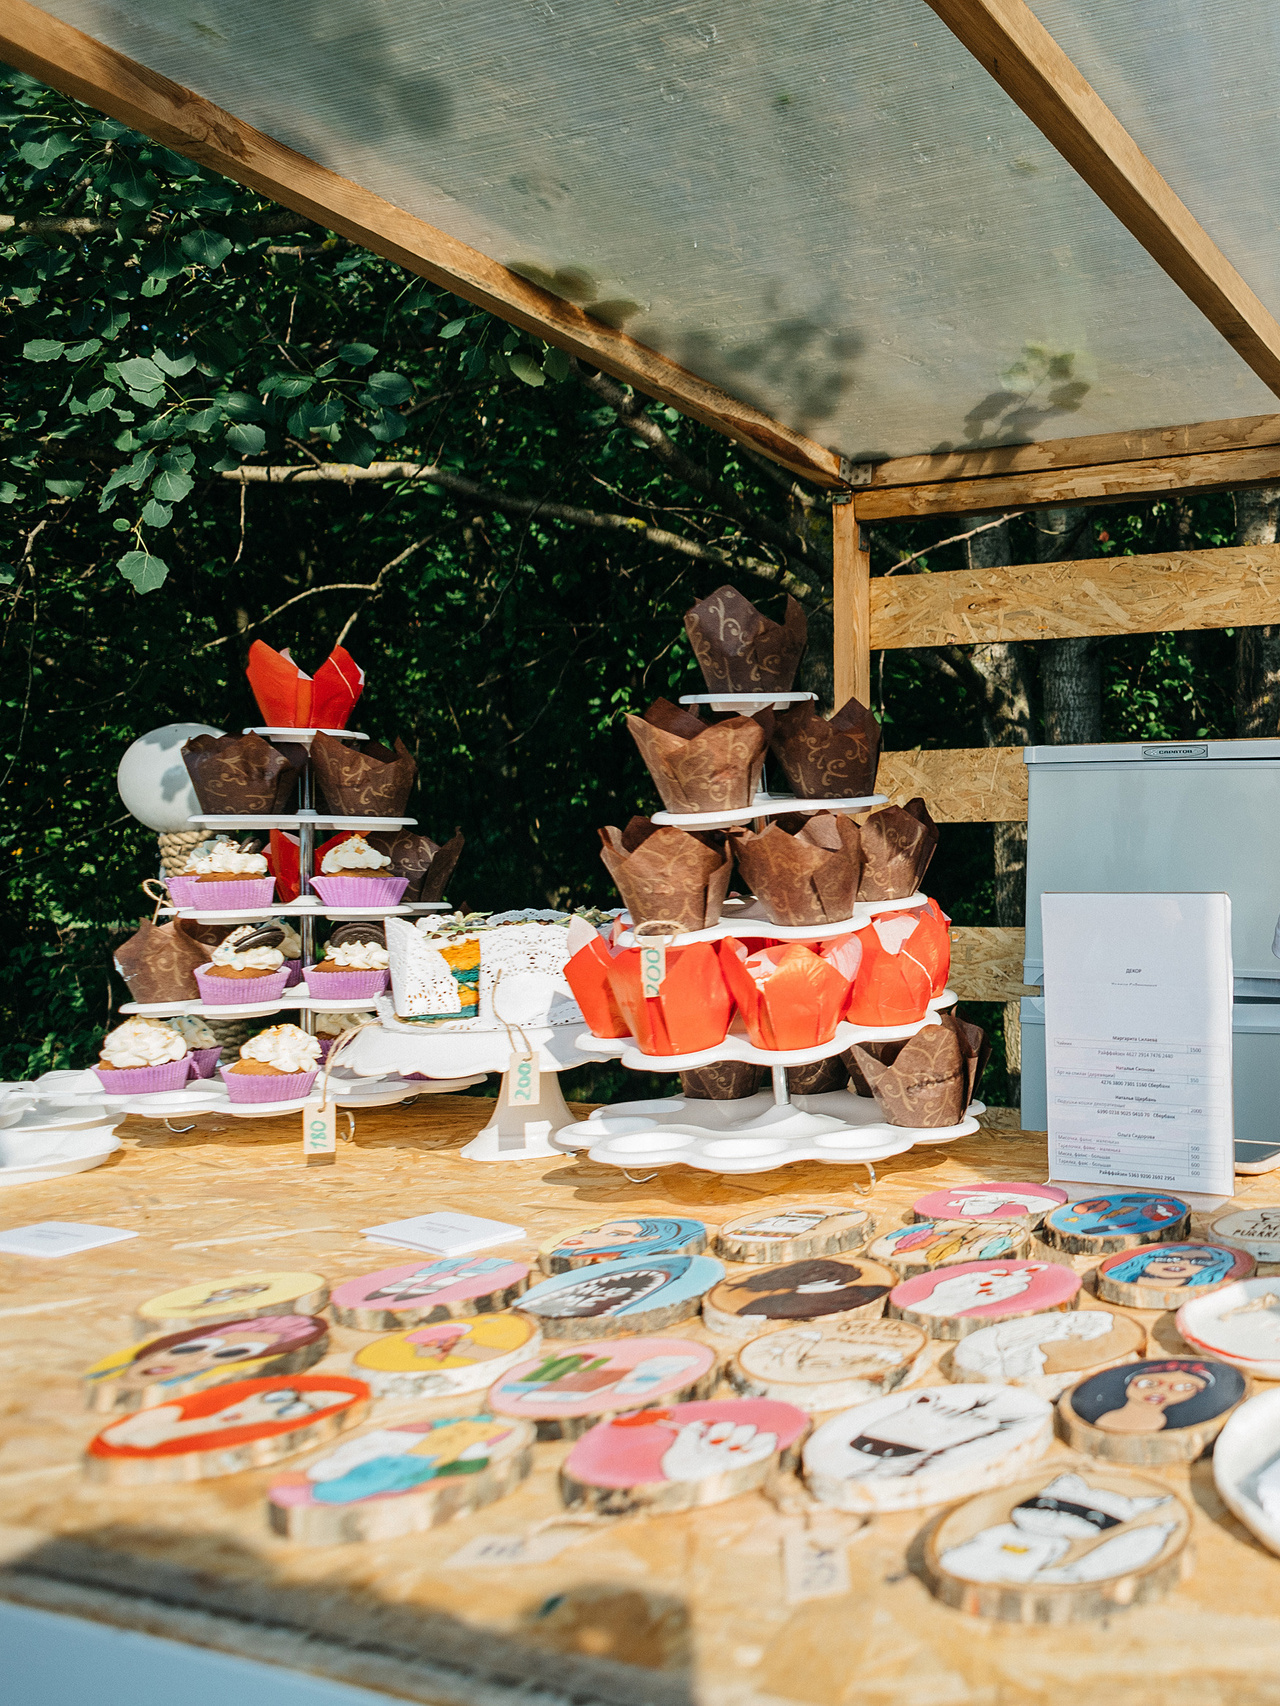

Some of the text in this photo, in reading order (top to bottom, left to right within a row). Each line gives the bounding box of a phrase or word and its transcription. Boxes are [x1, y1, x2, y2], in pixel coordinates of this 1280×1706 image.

[646, 949, 661, 995] 200
[514, 1062, 532, 1100] 200
[310, 1120, 327, 1149] 180
[1250, 1222, 1280, 1231] I'M
